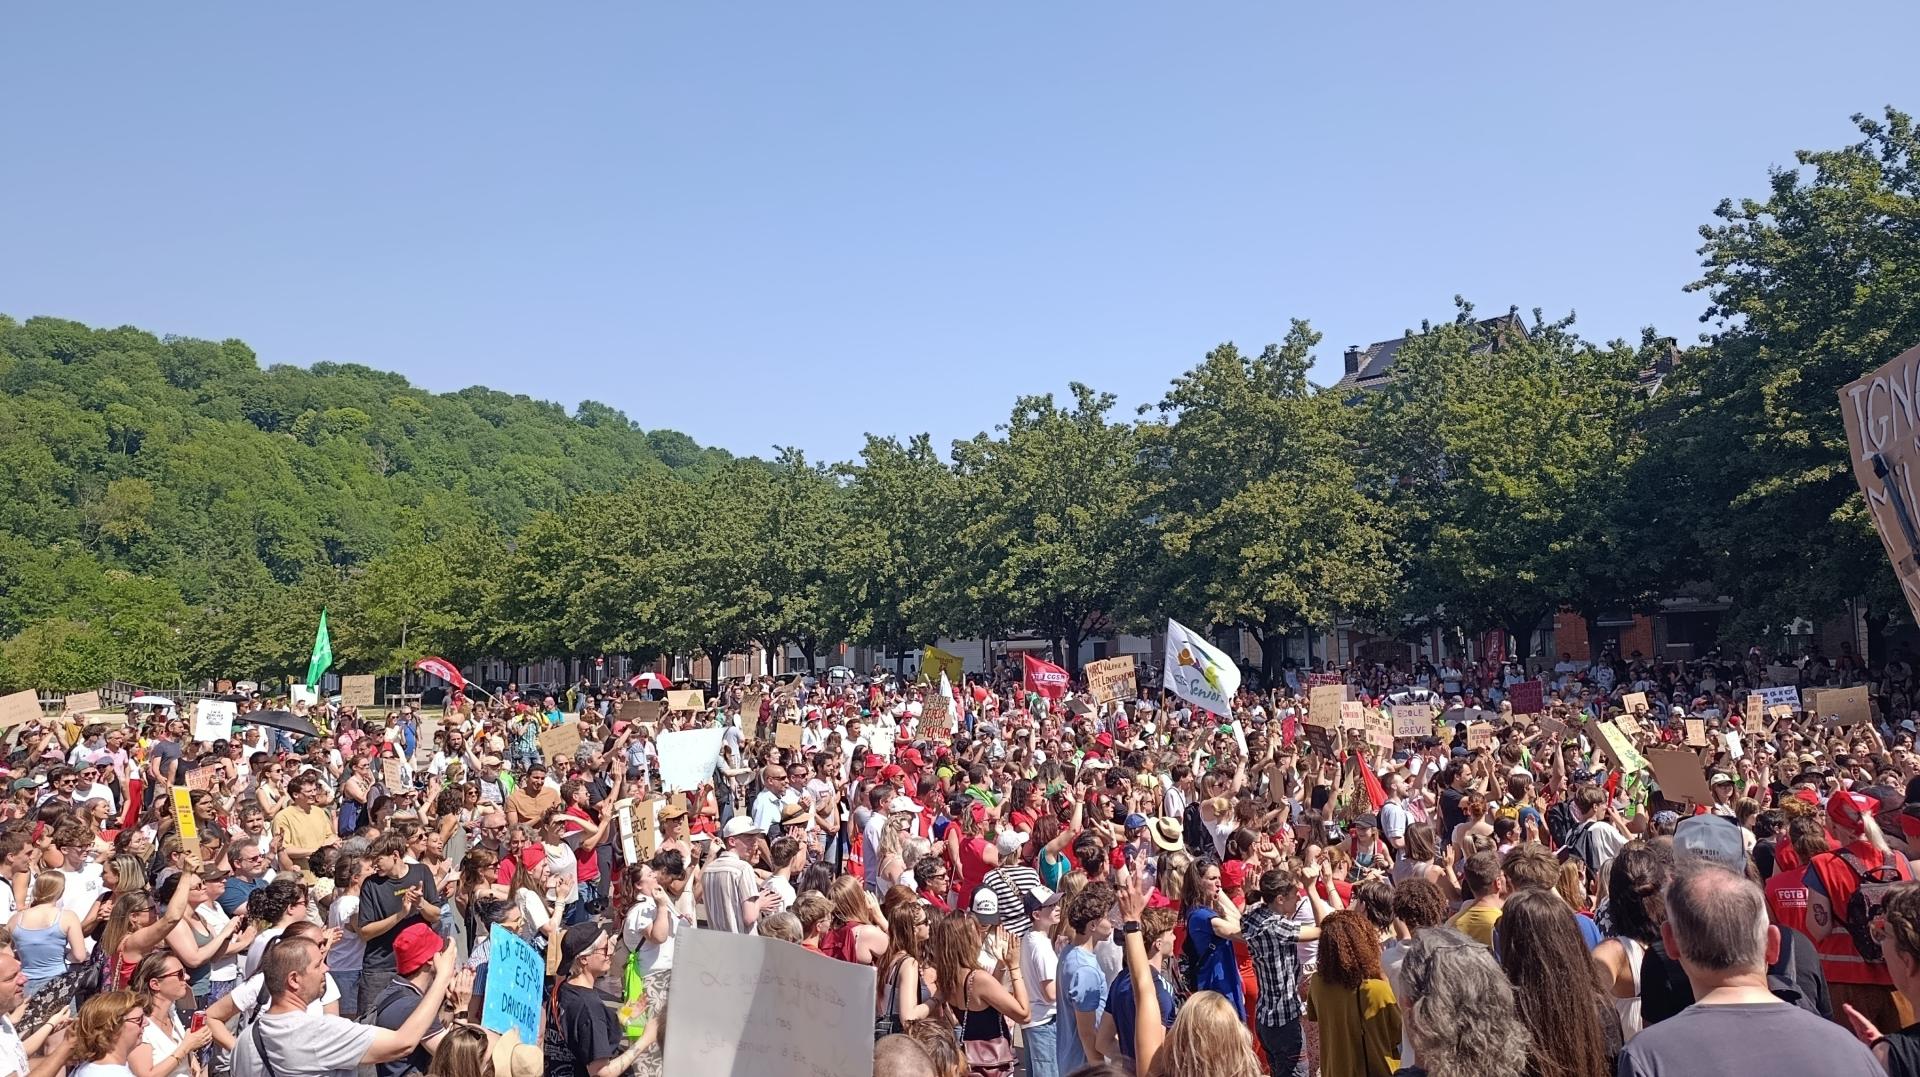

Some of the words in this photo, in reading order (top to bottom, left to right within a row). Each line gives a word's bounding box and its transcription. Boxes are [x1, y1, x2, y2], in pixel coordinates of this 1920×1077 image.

[1399, 726, 1426, 735] GREVE
[1778, 890, 1804, 899] FGTB
[500, 940, 511, 962] LA
[515, 965, 533, 993] EST
[501, 992, 520, 1019] DANS
